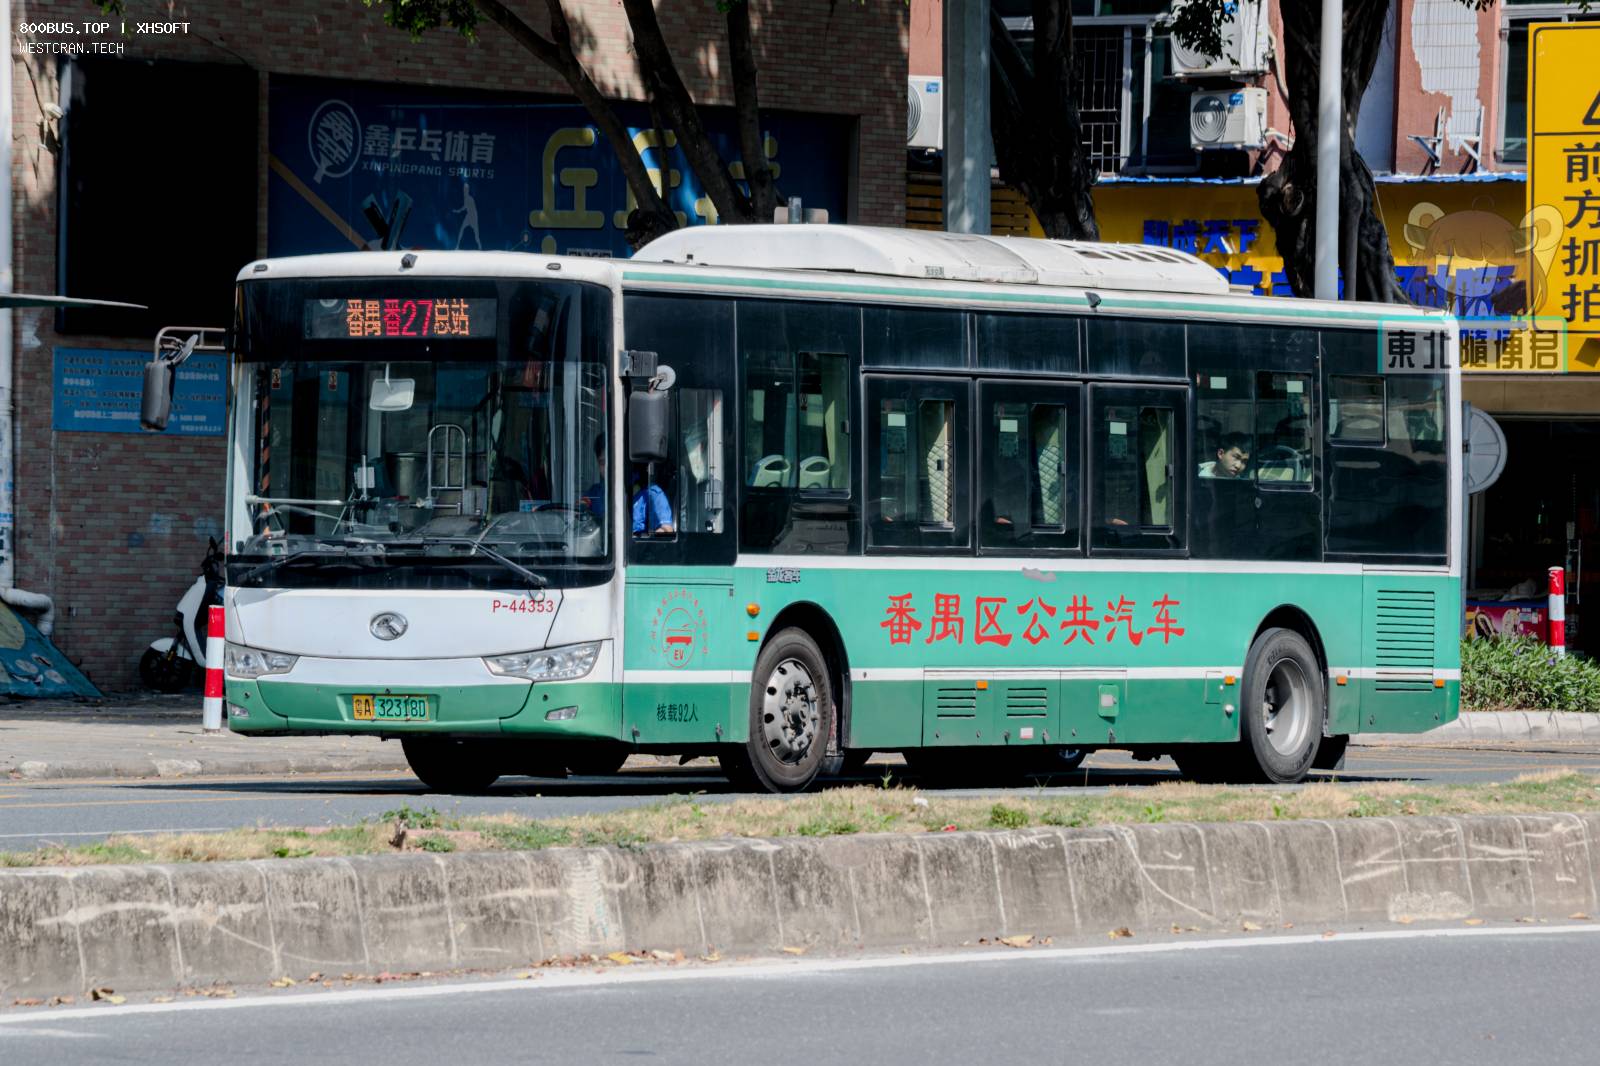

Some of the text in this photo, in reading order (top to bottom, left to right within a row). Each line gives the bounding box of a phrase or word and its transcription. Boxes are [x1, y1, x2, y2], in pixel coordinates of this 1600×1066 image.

[363, 124, 497, 164] 鑫乒乓体育
[361, 160, 496, 180] XINPINGPANG SPORTS
[1562, 141, 1600, 323] 前方抓拍
[492, 599, 554, 613] P-44353
[880, 591, 1186, 648] 番禺区公共汽车
[673, 649, 684, 661] EV
[656, 703, 698, 723] 核载92人
